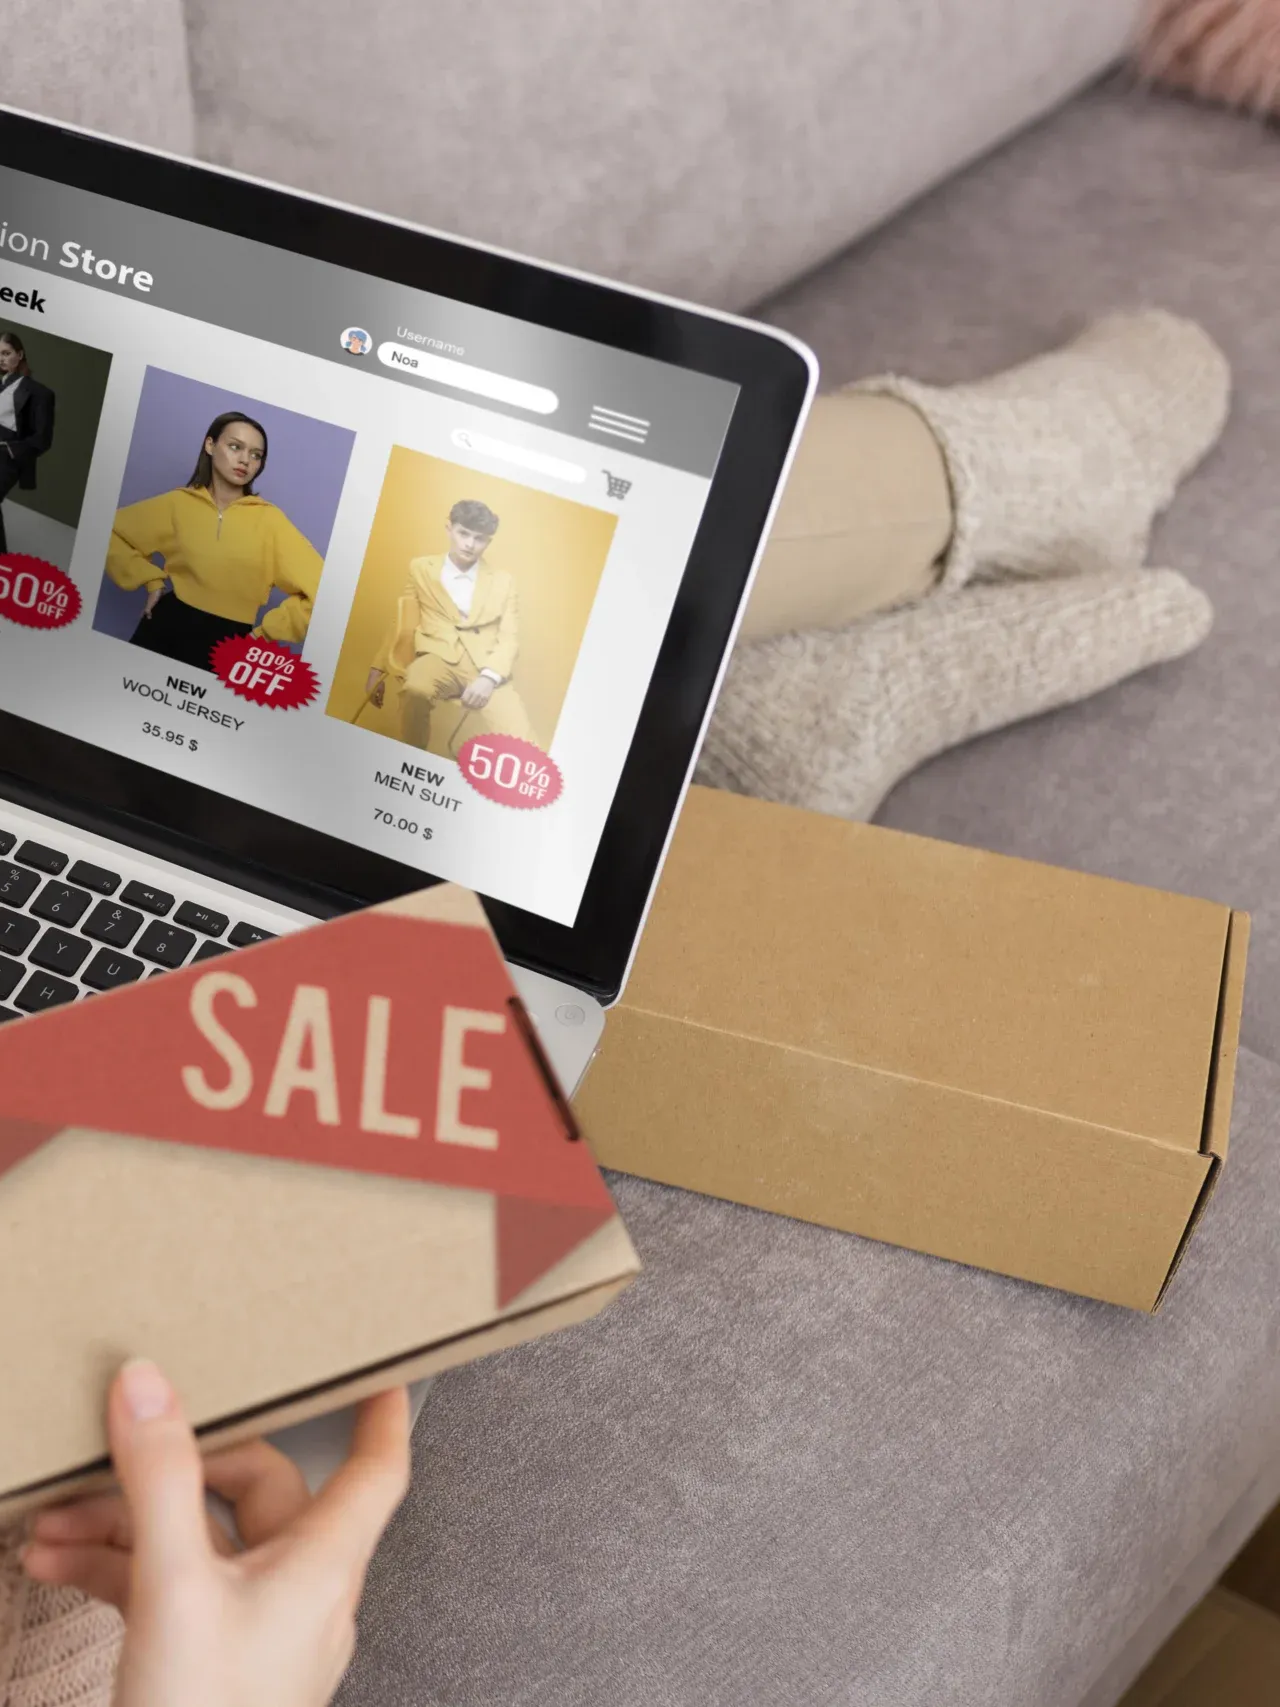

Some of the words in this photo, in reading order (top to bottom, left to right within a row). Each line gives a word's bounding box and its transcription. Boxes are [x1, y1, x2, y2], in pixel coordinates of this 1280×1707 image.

[59, 241, 154, 292] Store
[396, 326, 466, 356] Username
[391, 350, 419, 368] Noa
[37, 601, 66, 620] OFF
[245, 646, 295, 675] 80%
[166, 676, 207, 699] NEW
[228, 661, 292, 696] OFF
[123, 677, 172, 707] WOOL
[177, 699, 245, 731] JERSEY
[142, 721, 184, 746] 35.95
[188, 739, 199, 752] $
[400, 761, 445, 786] NEW
[469, 743, 550, 789] 50%
[374, 771, 415, 796] MEN
[419, 786, 463, 812] SUIT
[518, 781, 548, 800] OFF
[373, 808, 418, 834] 70.00
[422, 827, 433, 841] $
[10, 869, 20, 880] %
[0, 883, 12, 892] 5
[51, 903, 61, 912] 6
[112, 909, 122, 920] &
[3, 922, 15, 934] T
[104, 921, 115, 932] 7
[56, 942, 68, 954] Y
[156, 943, 166, 952] 8
[106, 963, 120, 975] U
[39, 986, 55, 1000] H
[181, 971, 507, 1151] SALE
